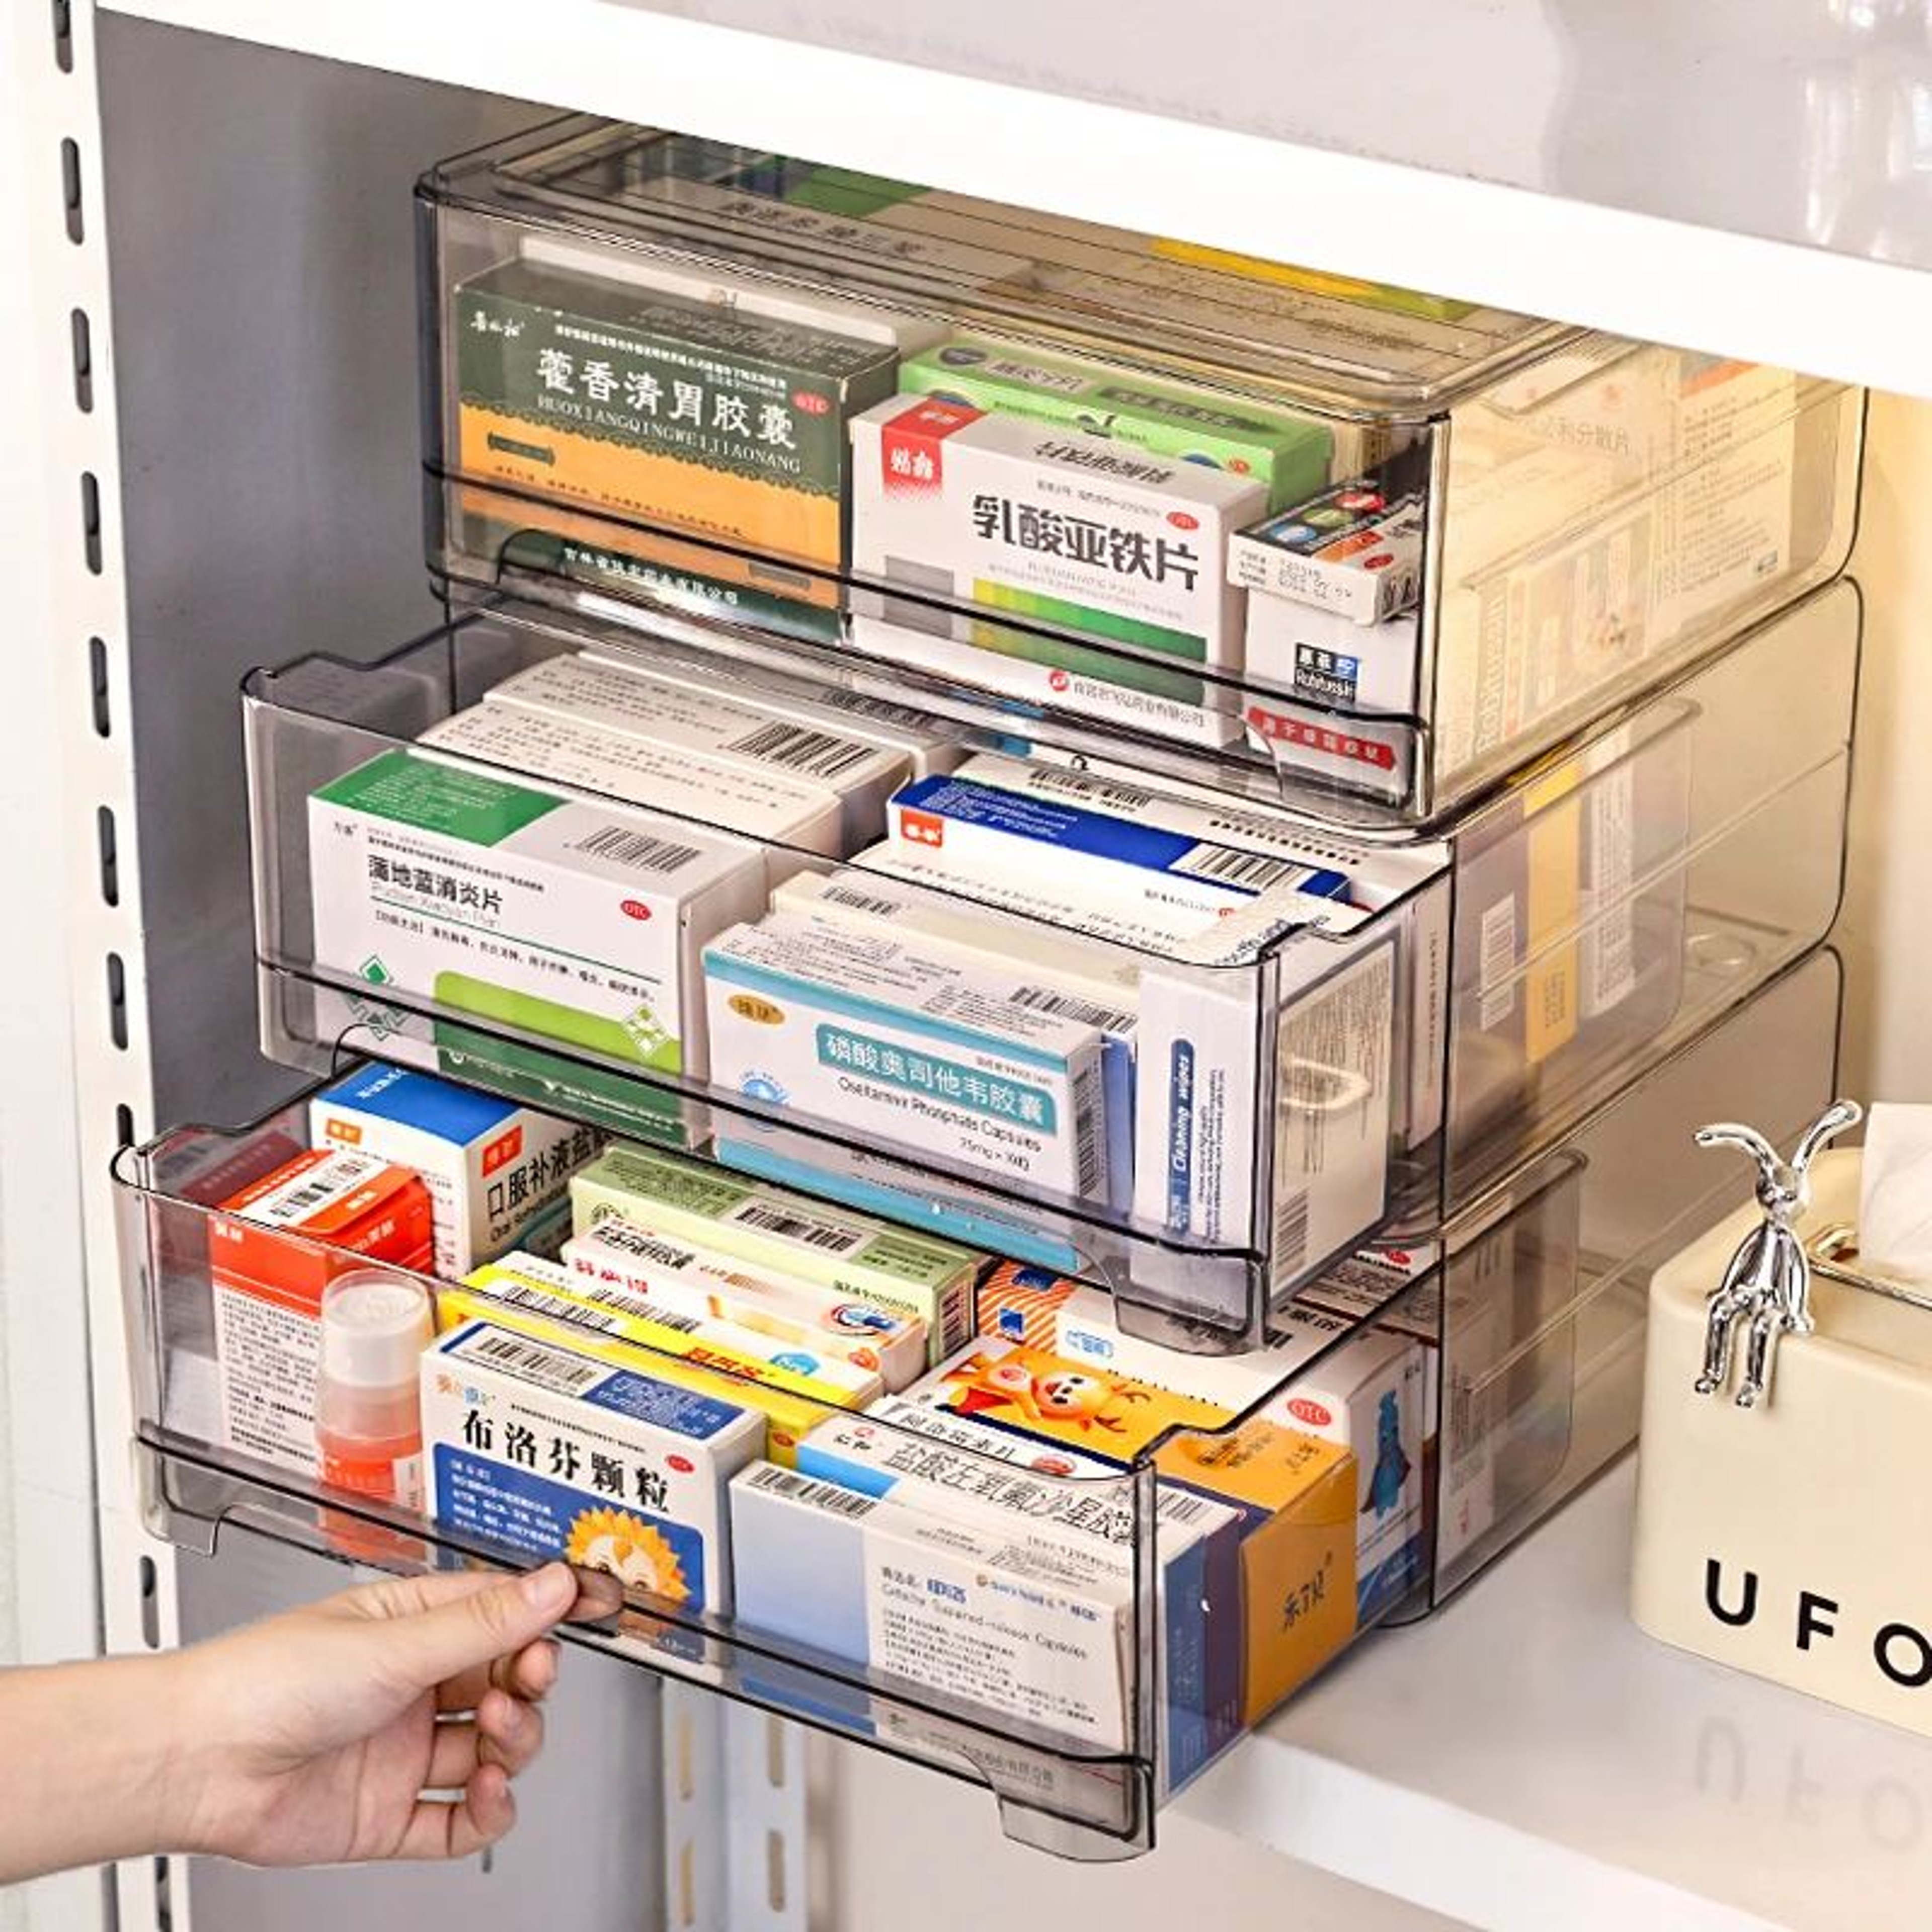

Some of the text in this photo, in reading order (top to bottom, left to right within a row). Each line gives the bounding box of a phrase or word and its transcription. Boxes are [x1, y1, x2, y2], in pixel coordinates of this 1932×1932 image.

[535, 348, 796, 449] 藿香清胃胶囊
[972, 494, 1200, 593] 乳酸亚铁片
[623, 903, 649, 919] OTC
[827, 1032, 1045, 1125] 磷酸奥司他韦胶囊
[1171, 1054, 1191, 1173] Cleaning wipes
[463, 1409, 669, 1512] 布洛芬颗粒
[1705, 1558, 1932, 1687] UFO
